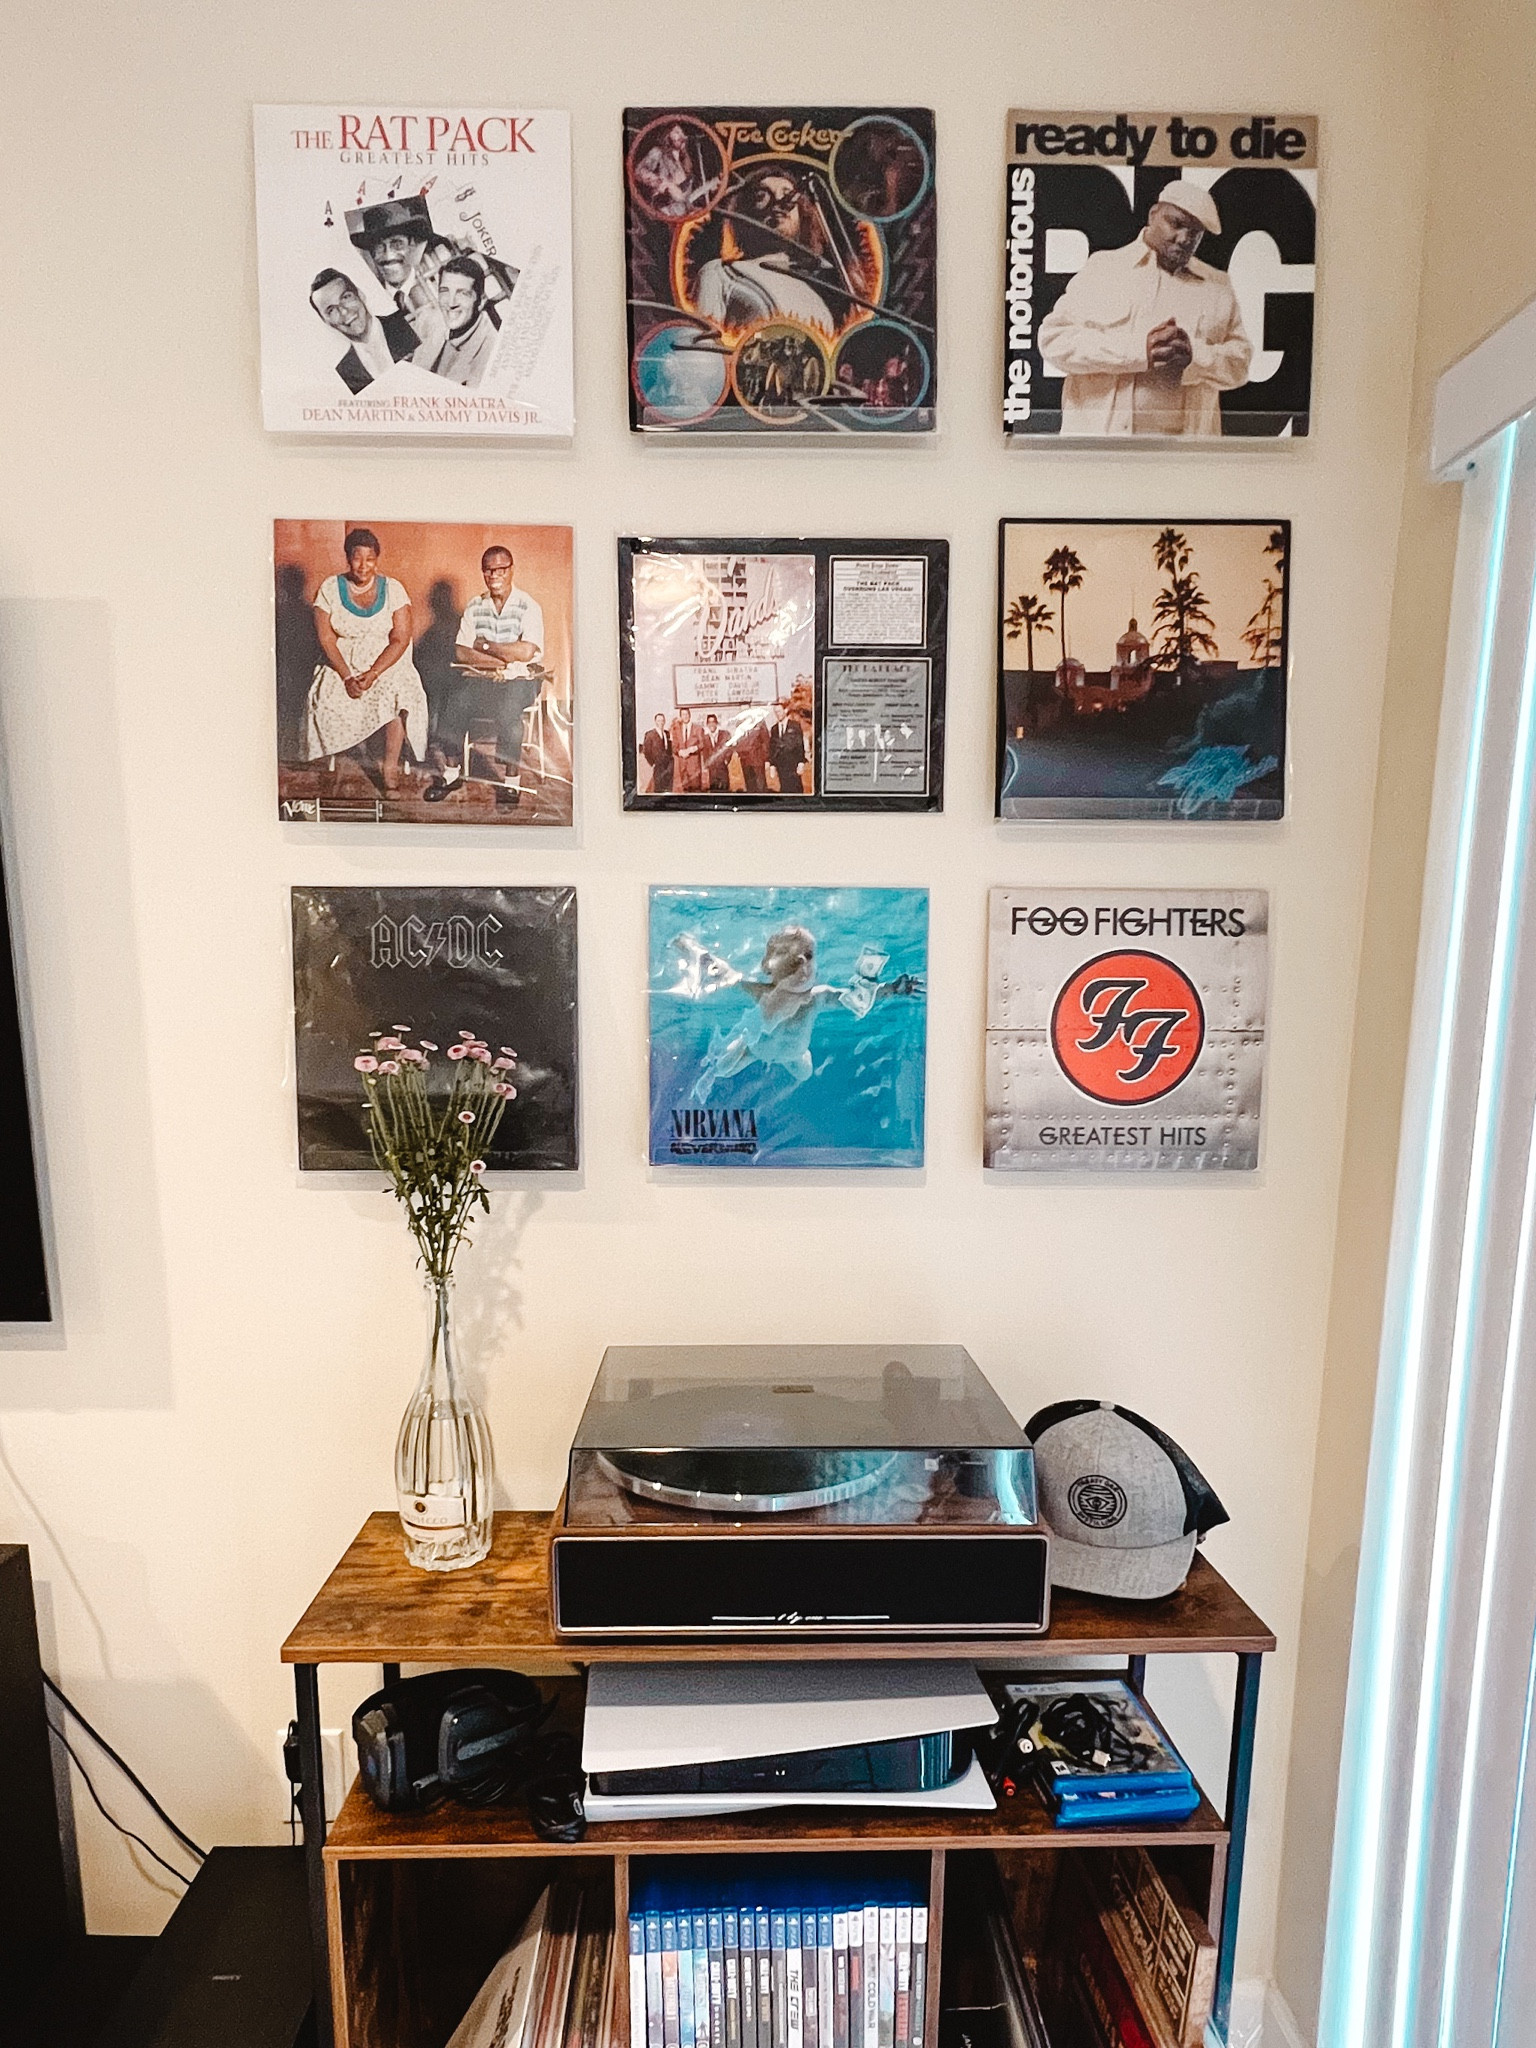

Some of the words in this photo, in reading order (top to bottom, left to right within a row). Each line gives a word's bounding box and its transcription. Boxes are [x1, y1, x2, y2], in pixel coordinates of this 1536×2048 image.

[292, 130, 333, 150] THE
[338, 114, 418, 150] RAT
[427, 116, 536, 153] PACK
[1014, 114, 1157, 166] ready
[1167, 116, 1218, 159] to
[1230, 115, 1307, 160] die
[340, 152, 434, 165] GREATEST
[447, 153, 490, 166] HITS
[459, 211, 497, 257] JOKER
[1006, 167, 1036, 350] notorious
[393, 396, 441, 408] FRANK
[444, 397, 506, 409] SINATRA
[1004, 359, 1032, 423] the
[302, 408, 343, 422] DEAN
[347, 409, 408, 422] MARTIN
[418, 410, 472, 423] SAMMY
[477, 410, 521, 423] DAVIS
[1011, 906, 1089, 936] FOO
[1095, 907, 1246, 938] FIGHTERS
[670, 1109, 758, 1138] NIRVANA
[1038, 1126, 1152, 1146] GREATEST
[1160, 1126, 1207, 1146] HITS
[790, 1969, 799, 1992] THE
[867, 1982, 876, 2008] COLD
[790, 1997, 799, 2030] CREW
